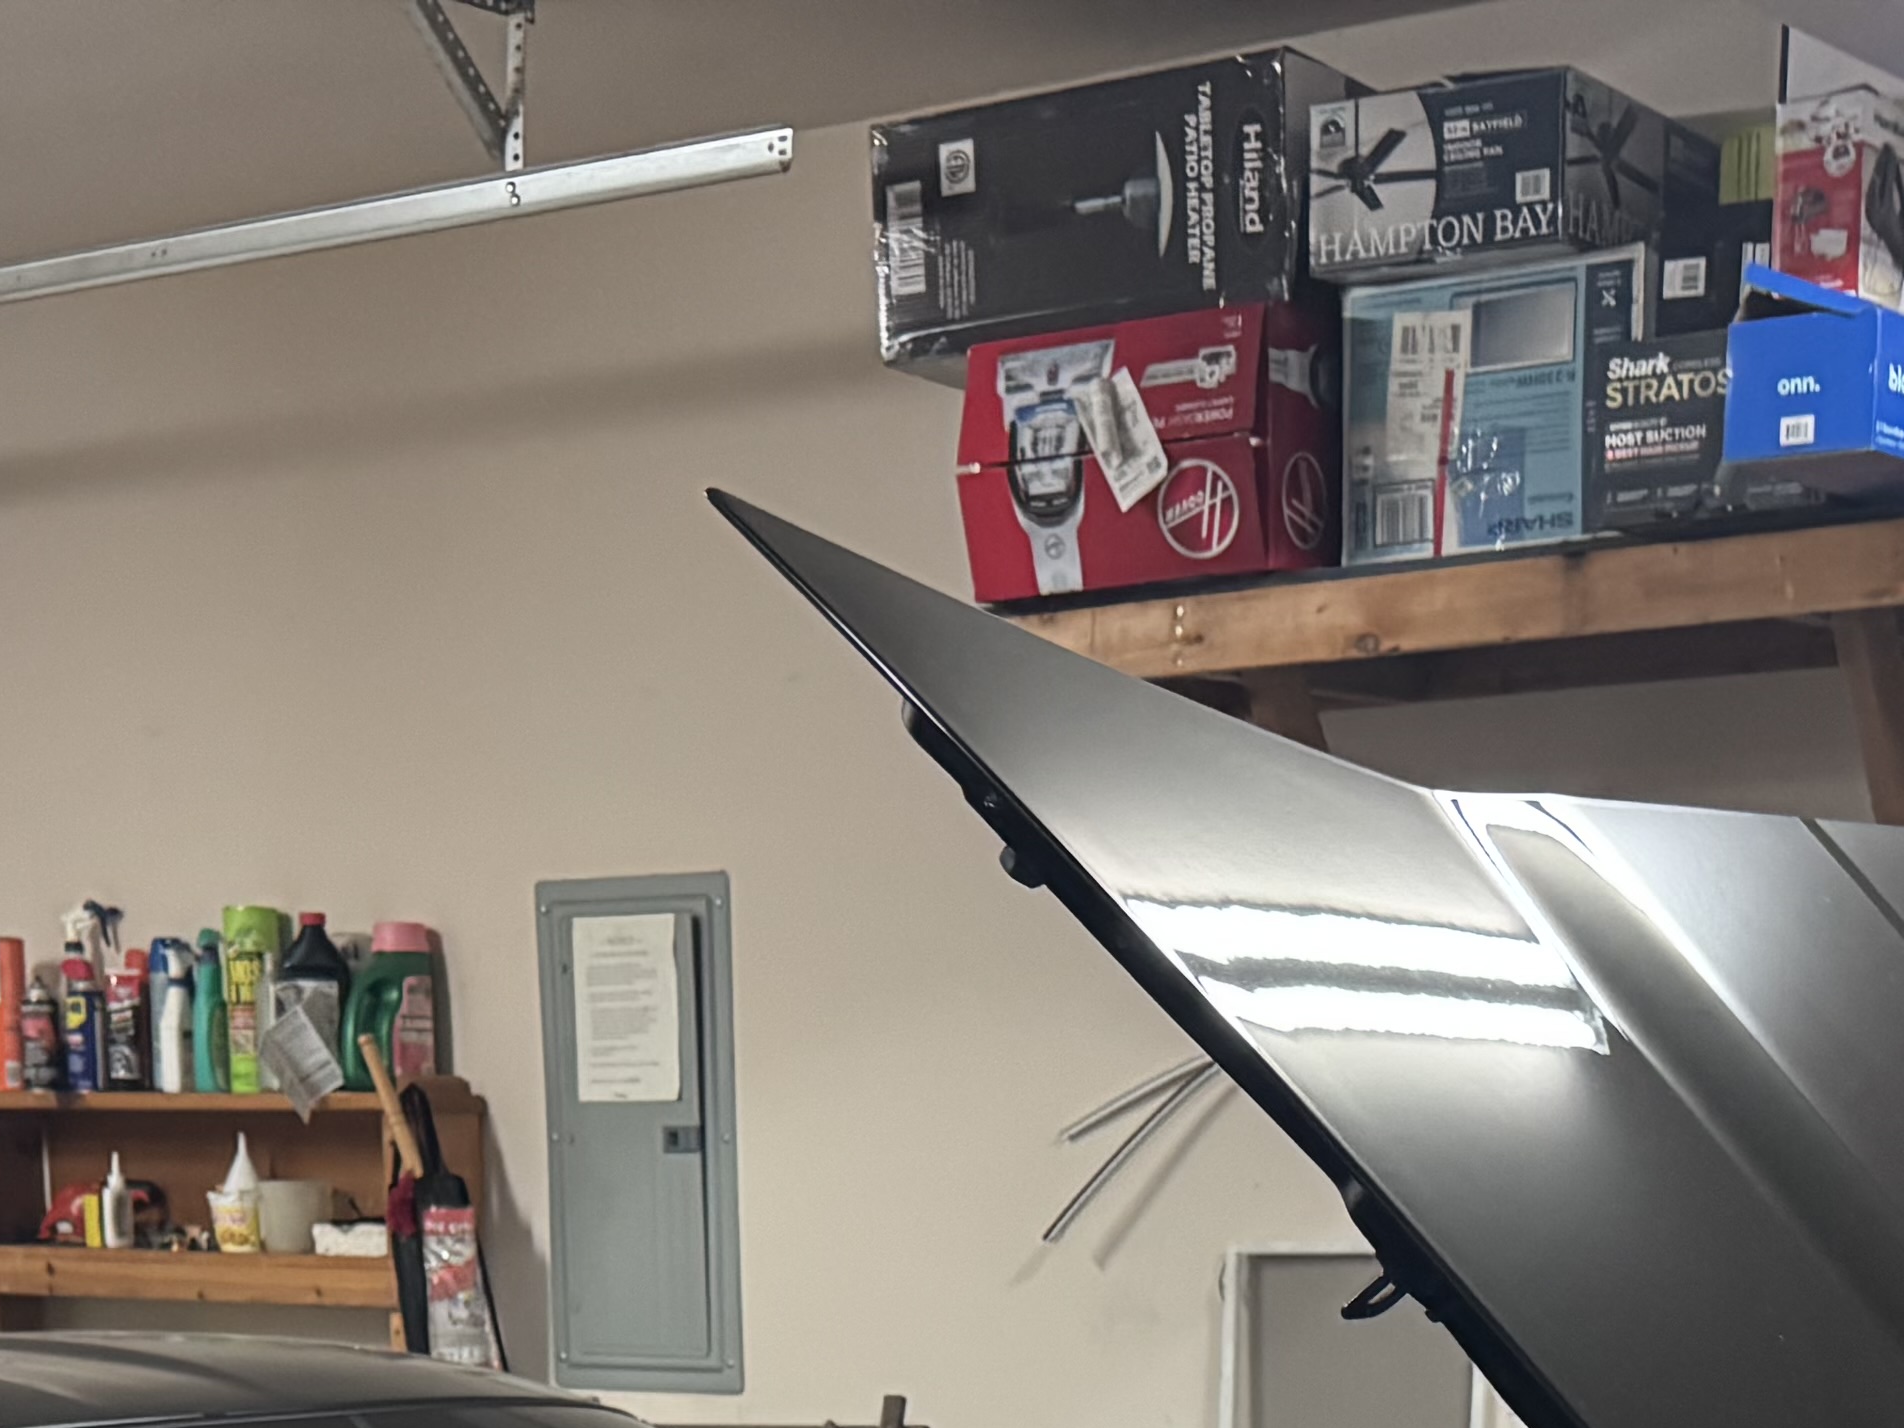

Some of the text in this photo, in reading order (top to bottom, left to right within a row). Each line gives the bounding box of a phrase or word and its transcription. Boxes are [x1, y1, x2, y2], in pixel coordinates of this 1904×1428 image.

[1184, 113, 1201, 264] PATIO HEATER
[1197, 80, 1217, 291] TABLETOP PROPANE
[1242, 123, 1265, 234] Hiland
[1318, 212, 1485, 265] HAMPTON
[1494, 202, 1555, 243] BAY
[1605, 368, 1733, 410] STRATOS
[1606, 351, 1671, 380] Shark
[1777, 374, 1822, 396] onn.
